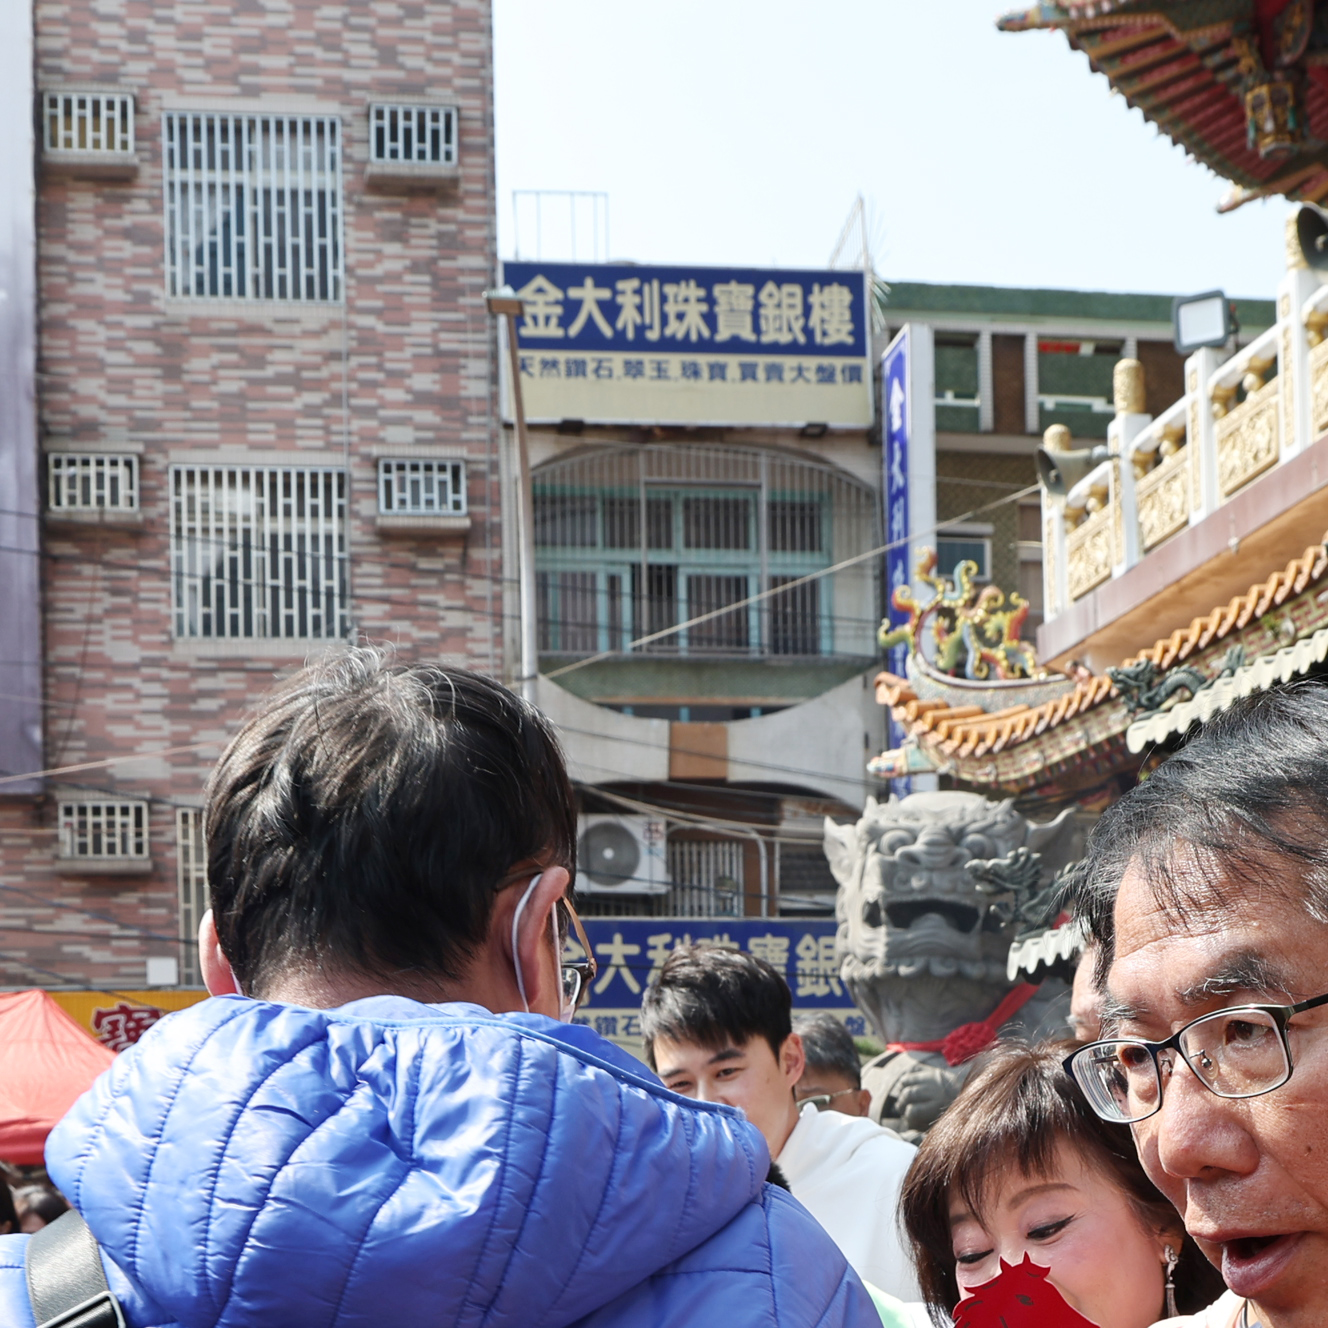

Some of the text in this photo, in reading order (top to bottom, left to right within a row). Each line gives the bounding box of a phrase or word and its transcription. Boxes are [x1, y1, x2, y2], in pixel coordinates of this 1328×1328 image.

[516, 273, 855, 346] 金大利珠寶銀樓
